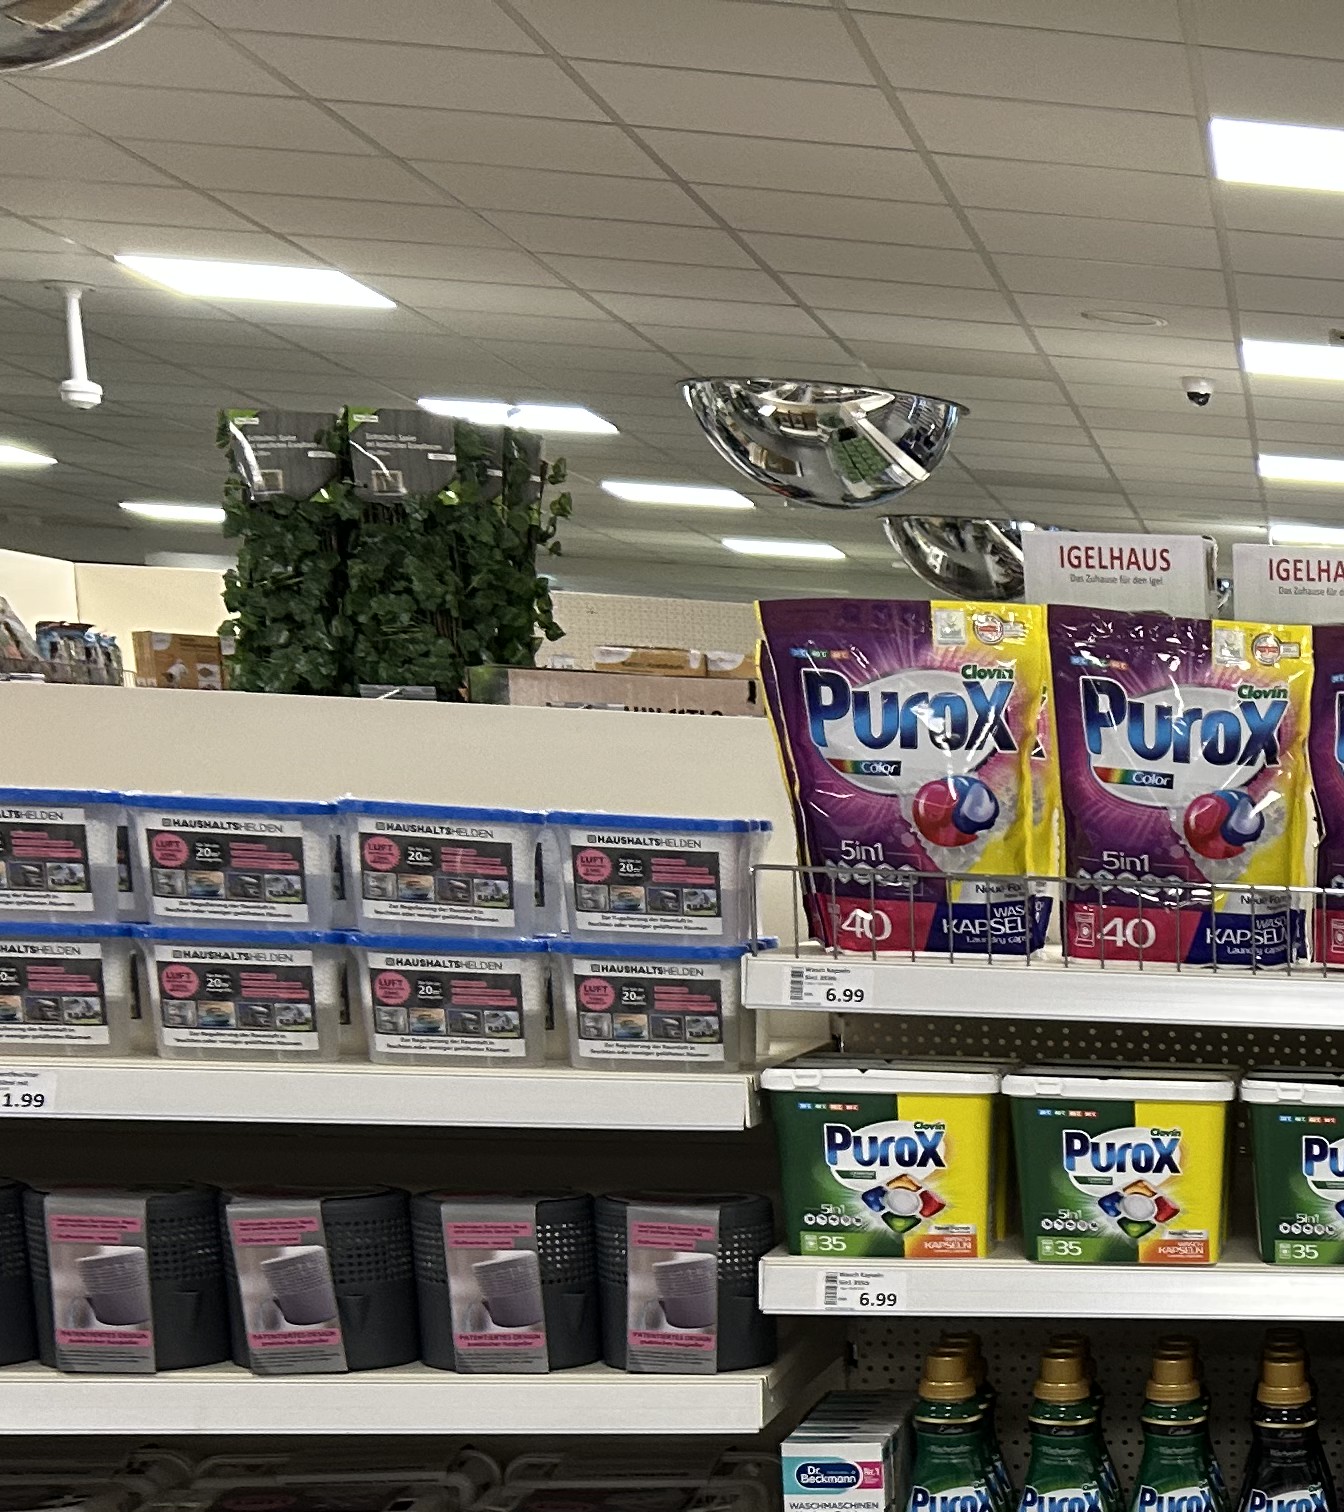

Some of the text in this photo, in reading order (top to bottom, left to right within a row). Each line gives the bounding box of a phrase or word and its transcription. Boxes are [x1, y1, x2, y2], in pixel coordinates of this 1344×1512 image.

[1059, 545, 1171, 572] IGELHAUS
[1238, 684, 1288, 700] Clovin
[802, 669, 1018, 753] PuroX
[1132, 772, 1170, 786] Color
[172, 817, 284, 834] HAUSHALTSHELDEN
[597, 834, 703, 850] HAUSHALTSHELDEN
[840, 840, 884, 861] 5in1
[1099, 918, 1156, 947] 40
[1063, 1129, 1182, 1174] PuroX
[819, 1236, 846, 1252] 35
[1292, 1242, 1318, 1258] 35
[859, 1292, 897, 1308] 6.99
[806, 1465, 821, 1476] Dr.
[800, 1474, 856, 1485] Beckmann
[789, 1502, 879, 1510] WASCHMASCHINEN
